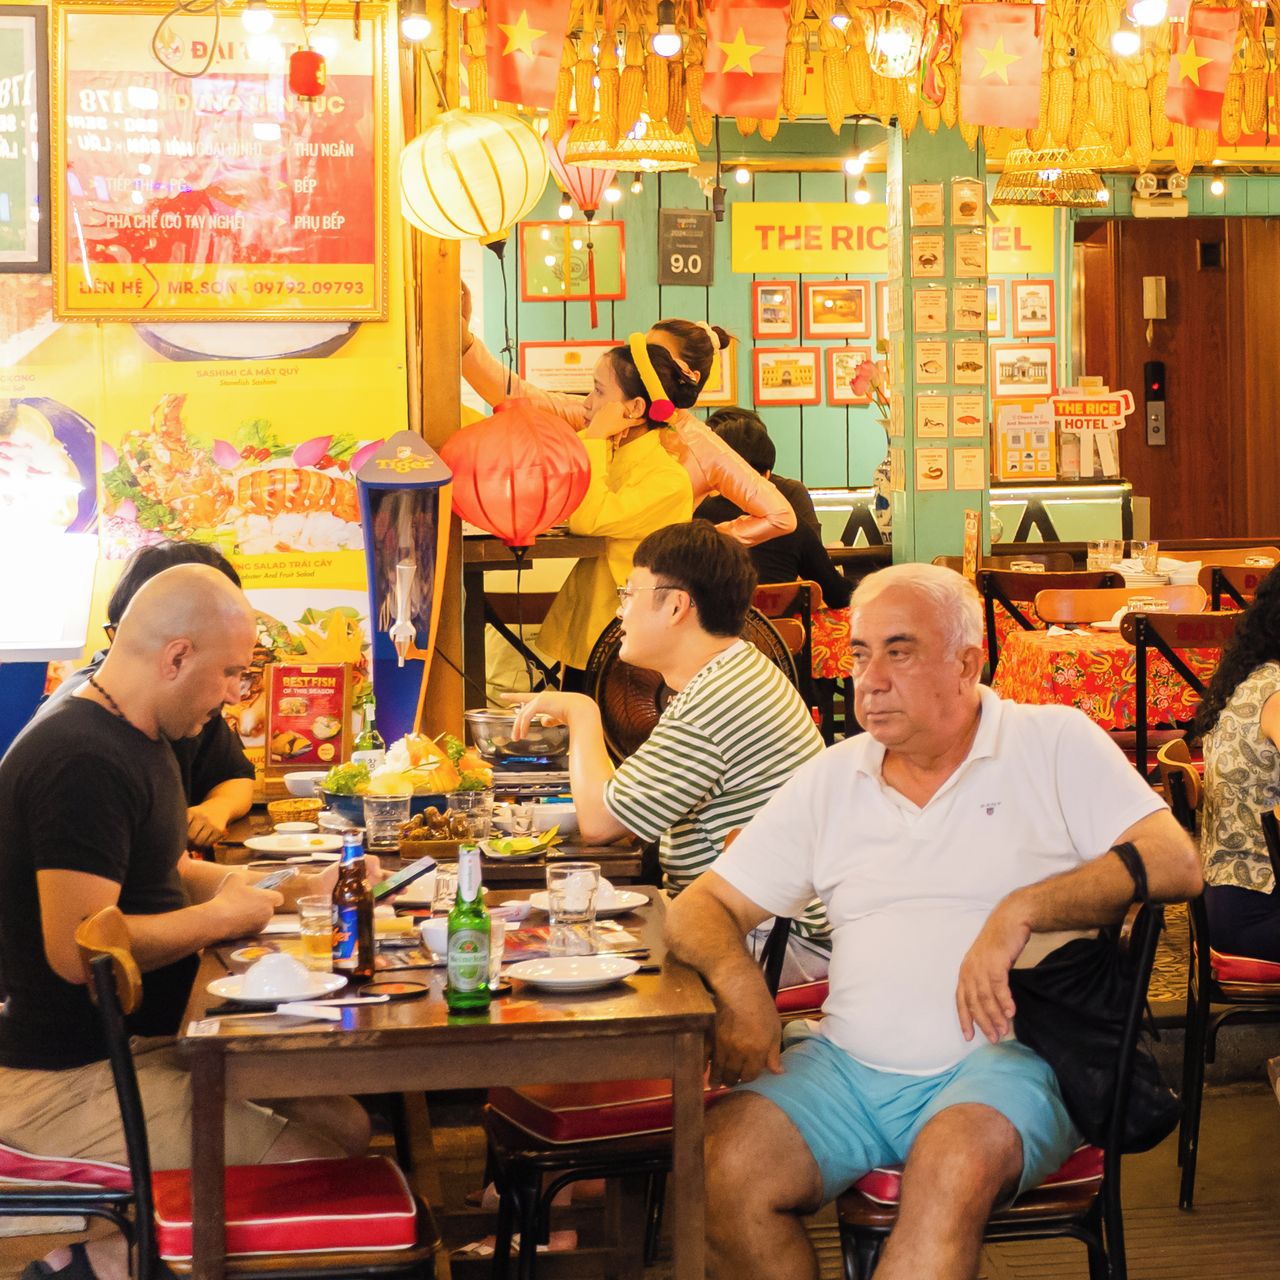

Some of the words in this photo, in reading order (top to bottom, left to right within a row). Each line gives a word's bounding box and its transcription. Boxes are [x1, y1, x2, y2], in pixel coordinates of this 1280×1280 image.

[294, 142, 318, 158] THU
[321, 139, 354, 158] NGÂN
[294, 175, 318, 194] BẾP
[106, 214, 131, 229] PHA
[133, 209, 159, 229] CHẾ
[184, 214, 206, 229] TAY
[294, 214, 322, 233] PHỤ
[323, 210, 346, 230] BẾP
[754, 225, 823, 251] THE
[831, 225, 888, 251] RIC
[670, 253, 702, 274] 9.0
[122, 277, 144, 299] HỆ
[253, 280, 365, 295] 09792.09793
[196, 369, 237, 378] SASHIMI
[1057, 402, 1083, 415] THE
[1087, 402, 1118, 415] RICE
[1064, 418, 1109, 430] HOTEL
[375, 458, 434, 474] Tiger
[254, 561, 286, 570] SALAD
[283, 676, 309, 688] BEST
[311, 677, 336, 687] FISH
